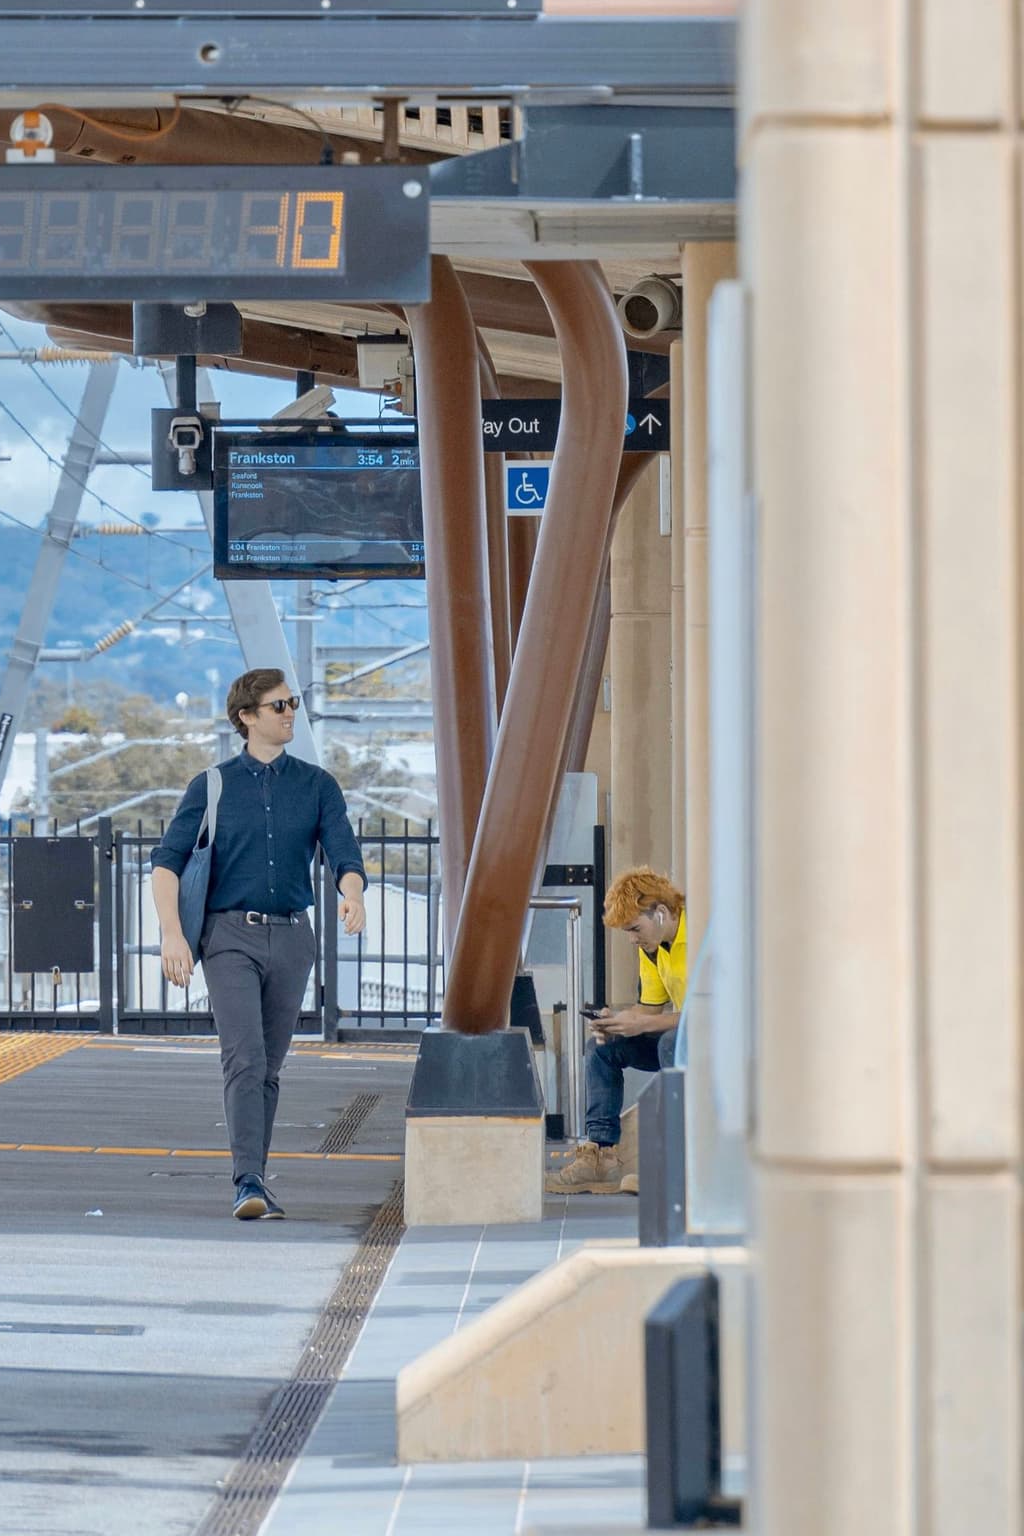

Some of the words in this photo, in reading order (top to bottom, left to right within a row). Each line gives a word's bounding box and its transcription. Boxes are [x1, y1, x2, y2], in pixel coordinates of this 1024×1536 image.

[482, 418, 503, 438] ay
[508, 417, 540, 434] Out
[229, 452, 295, 464] Frankston
[358, 455, 384, 465] 3:54
[232, 472, 258, 480] Seaford
[232, 491, 264, 499] Frankston
